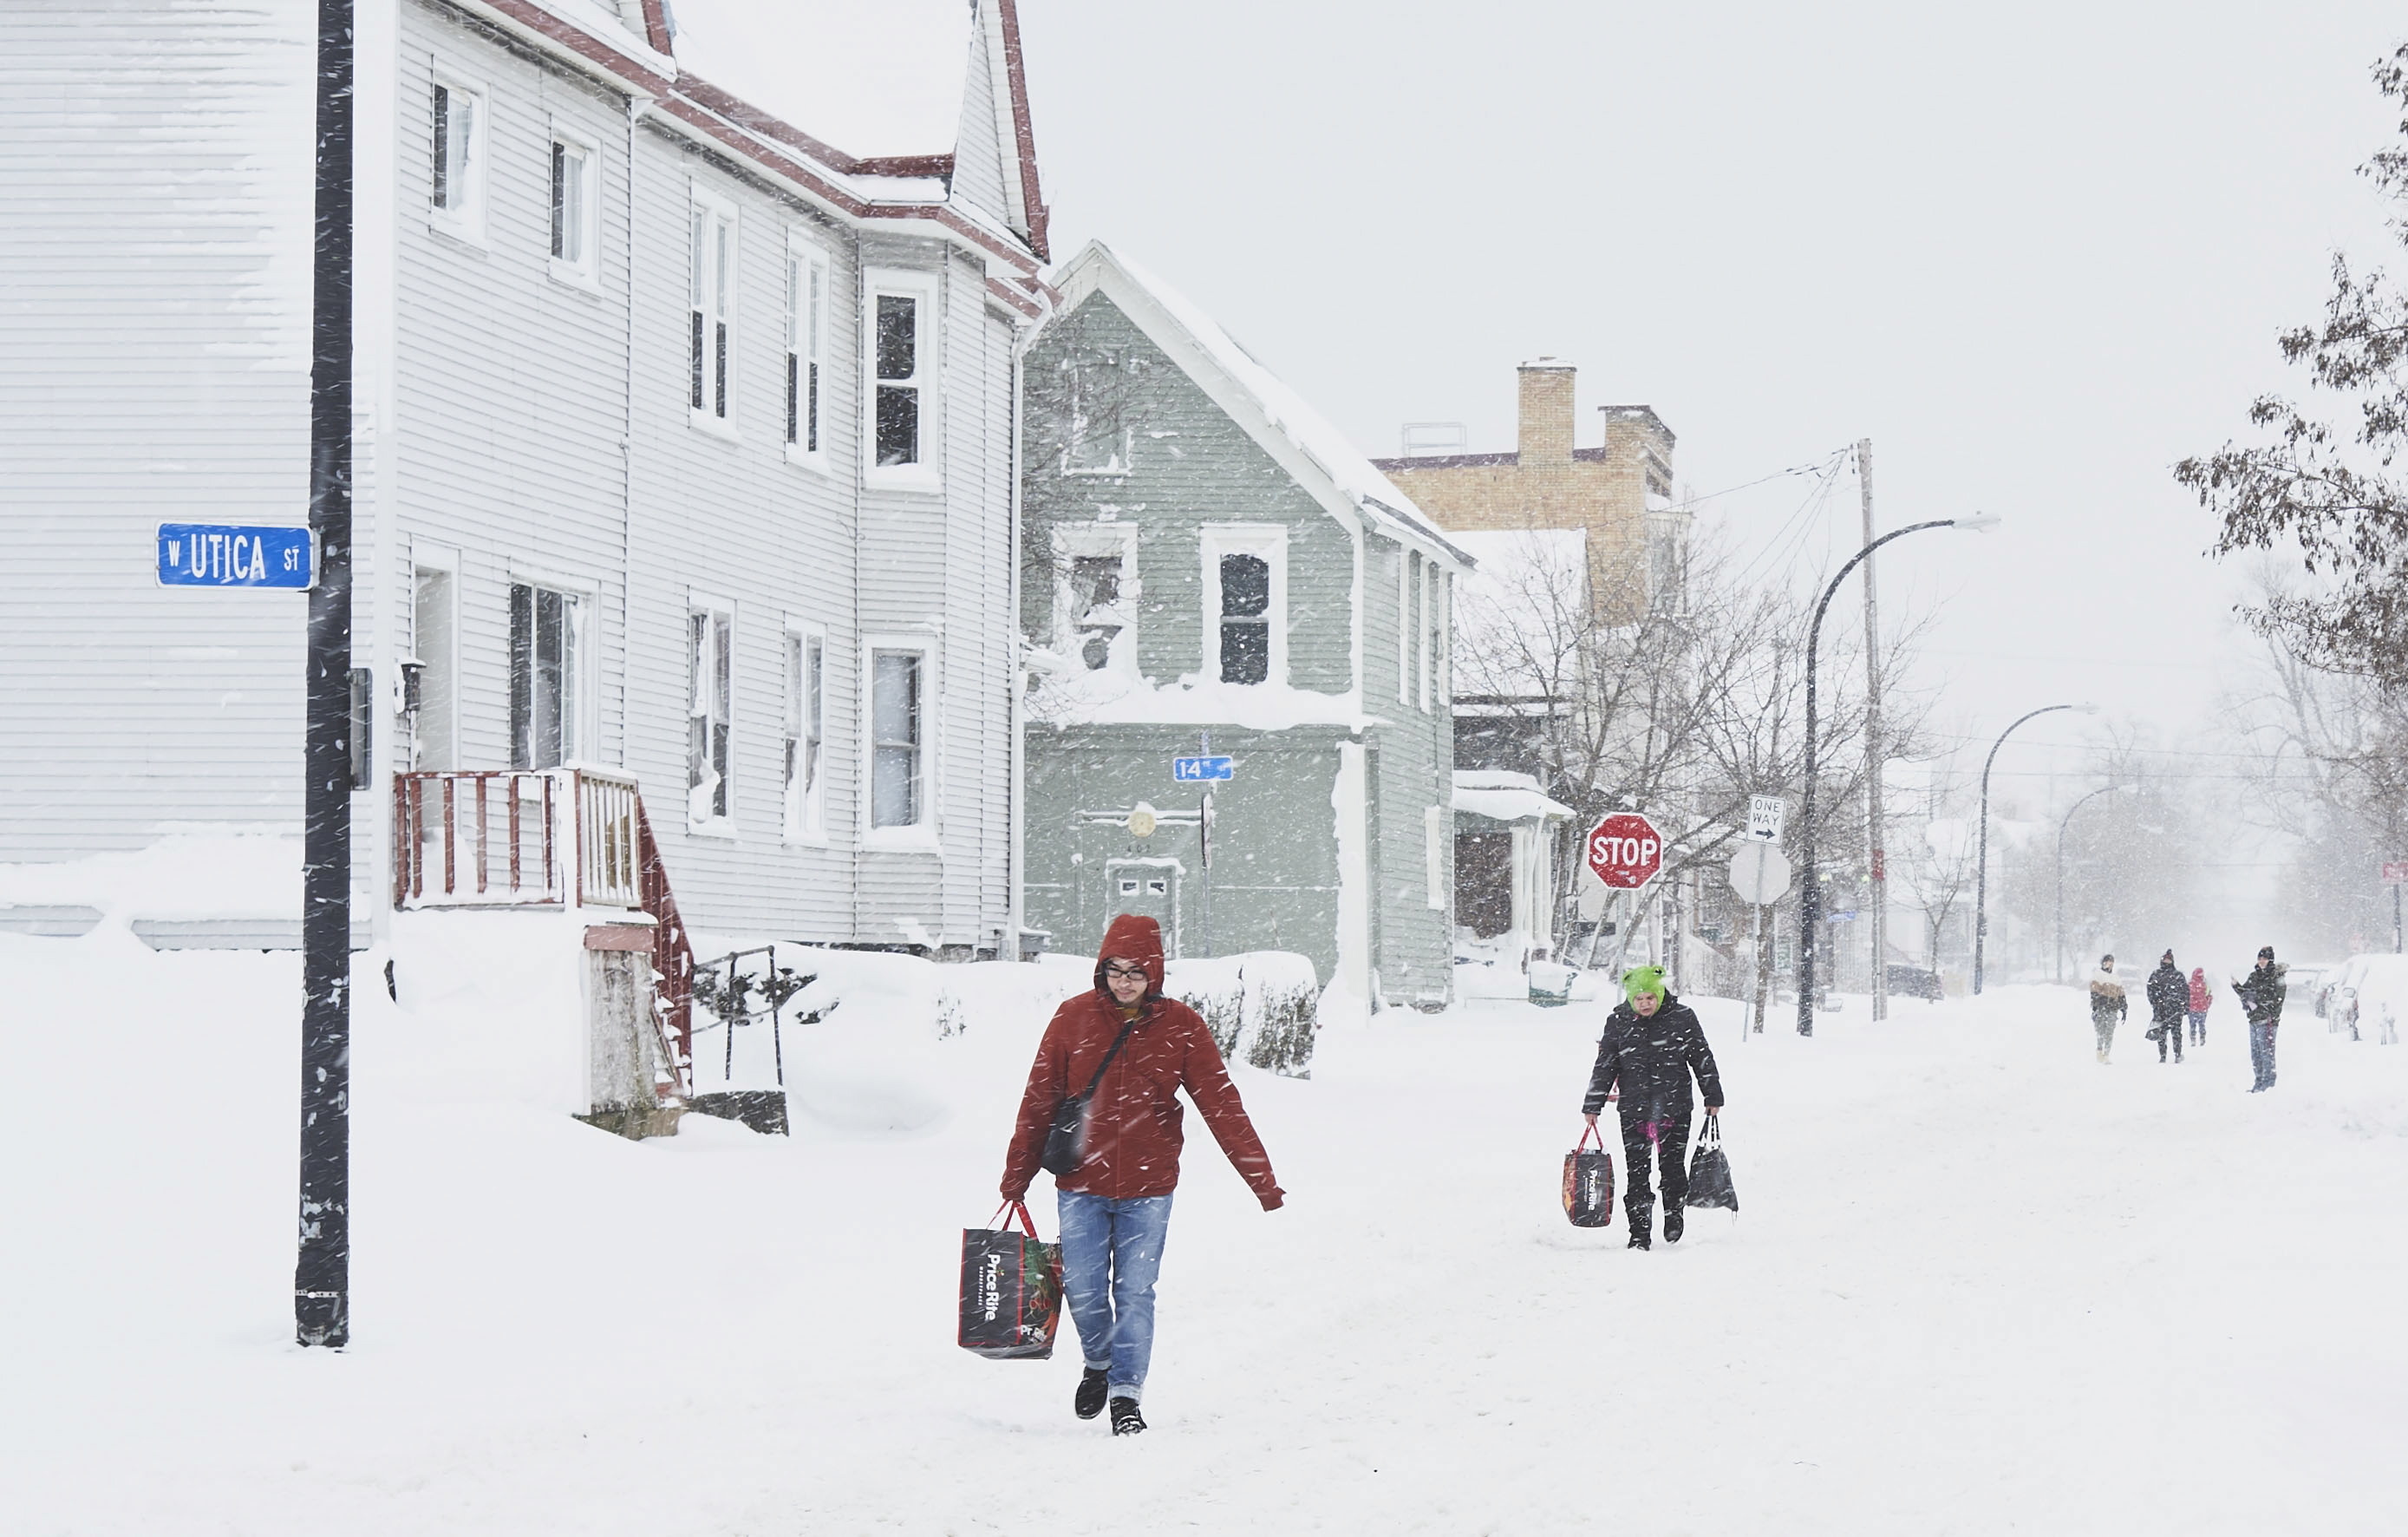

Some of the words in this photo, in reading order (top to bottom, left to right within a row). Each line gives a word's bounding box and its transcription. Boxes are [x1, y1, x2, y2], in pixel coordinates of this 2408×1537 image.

[168, 540, 180, 566] W
[191, 533, 266, 579] UTICA
[284, 547, 300, 571] ST
[1752, 813, 1779, 827] WAY
[1755, 799, 1781, 813] ONE
[1592, 836, 1658, 867] STOP
[986, 1253, 1001, 1292] Price
[985, 1292, 1000, 1321] Rite
